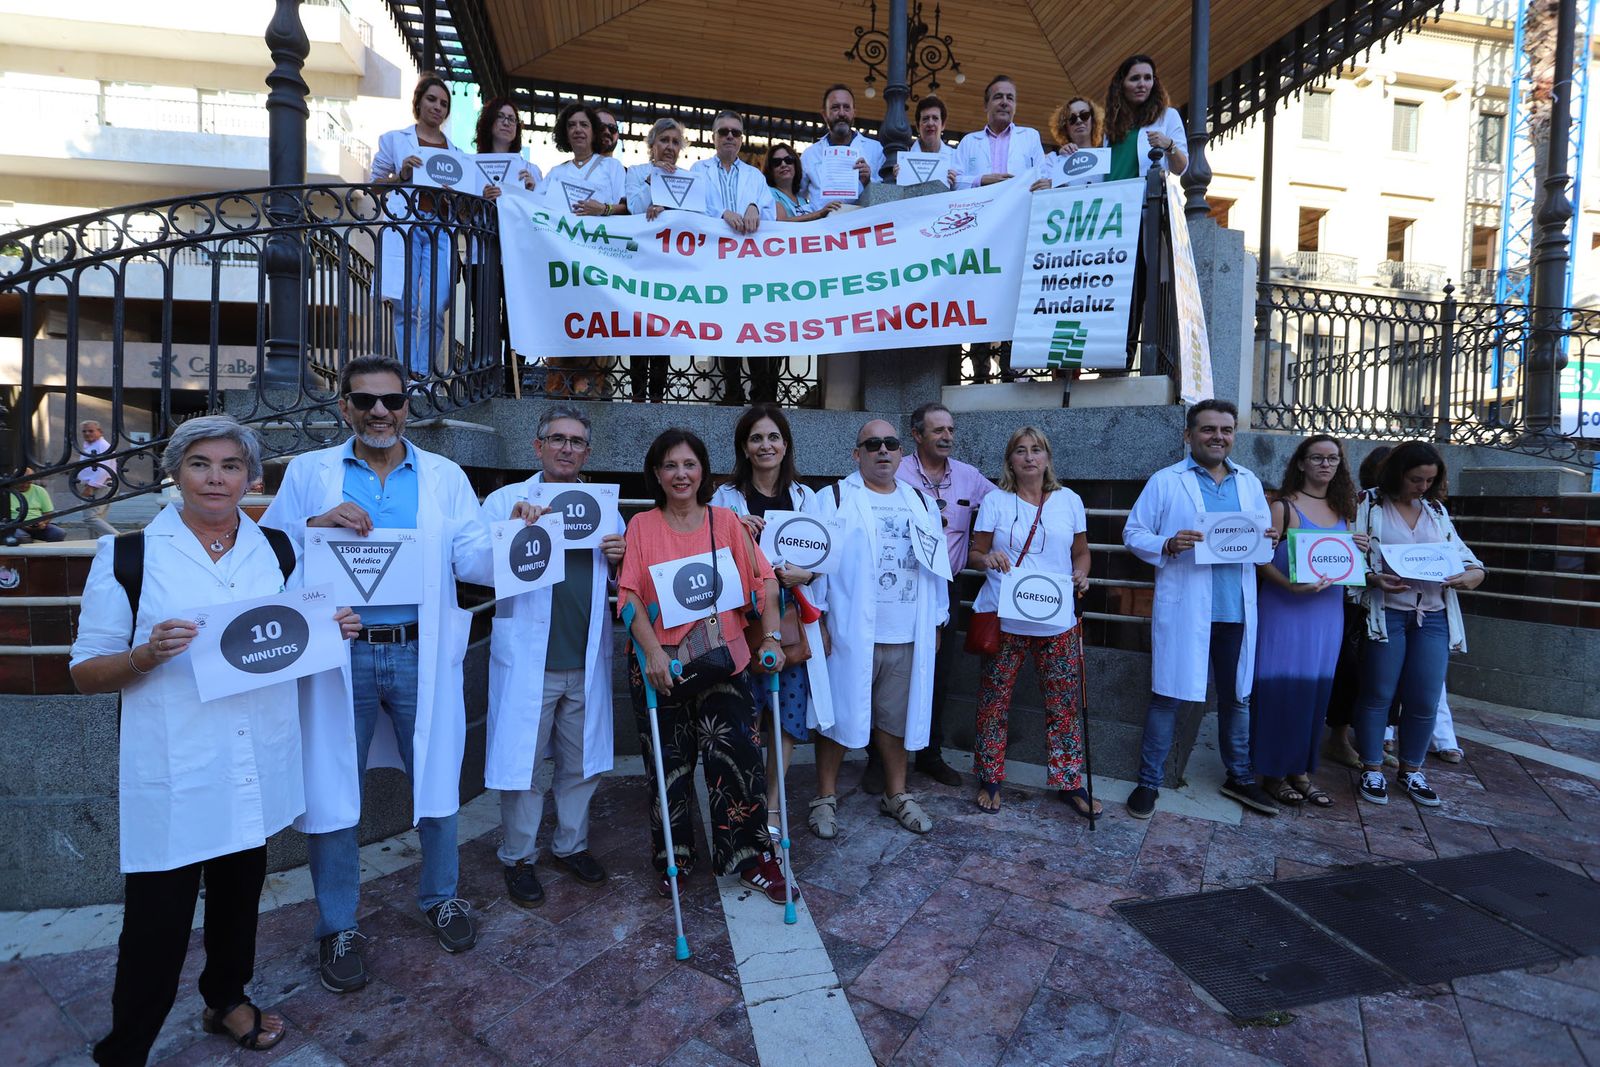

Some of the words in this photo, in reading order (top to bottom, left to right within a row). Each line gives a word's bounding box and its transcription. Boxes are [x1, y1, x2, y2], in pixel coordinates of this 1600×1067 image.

[436, 161, 454, 173] NO
[1072, 155, 1088, 166] NO
[1042, 197, 1123, 245] SMA
[717, 222, 897, 260] PACIENTE
[1032, 247, 1128, 271] Sindicato
[548, 261, 729, 304] DIGNIDAD
[742, 247, 1002, 305] PROFESIONAL
[1040, 271, 1114, 291] Médico
[1033, 294, 1115, 315] Andaluz
[564, 311, 723, 341] CALIDAD
[735, 300, 988, 344] ASISTENCIAL
[566, 503, 586, 518] 10
[340, 546, 361, 554] 1500
[362, 545, 393, 554] adultos
[525, 539, 541, 557] 10
[778, 536, 829, 551] AGRESION
[352, 556, 381, 565] Médico
[517, 559, 546, 573] MINUTOS
[1311, 555, 1353, 564] AGRESION
[352, 567, 381, 575] Familia
[688, 573, 708, 590] 10
[685, 592, 714, 605] MINUTO
[1016, 590, 1062, 605] AGRESION
[250, 620, 283, 644] 10
[241, 644, 298, 664] MINUTOS
